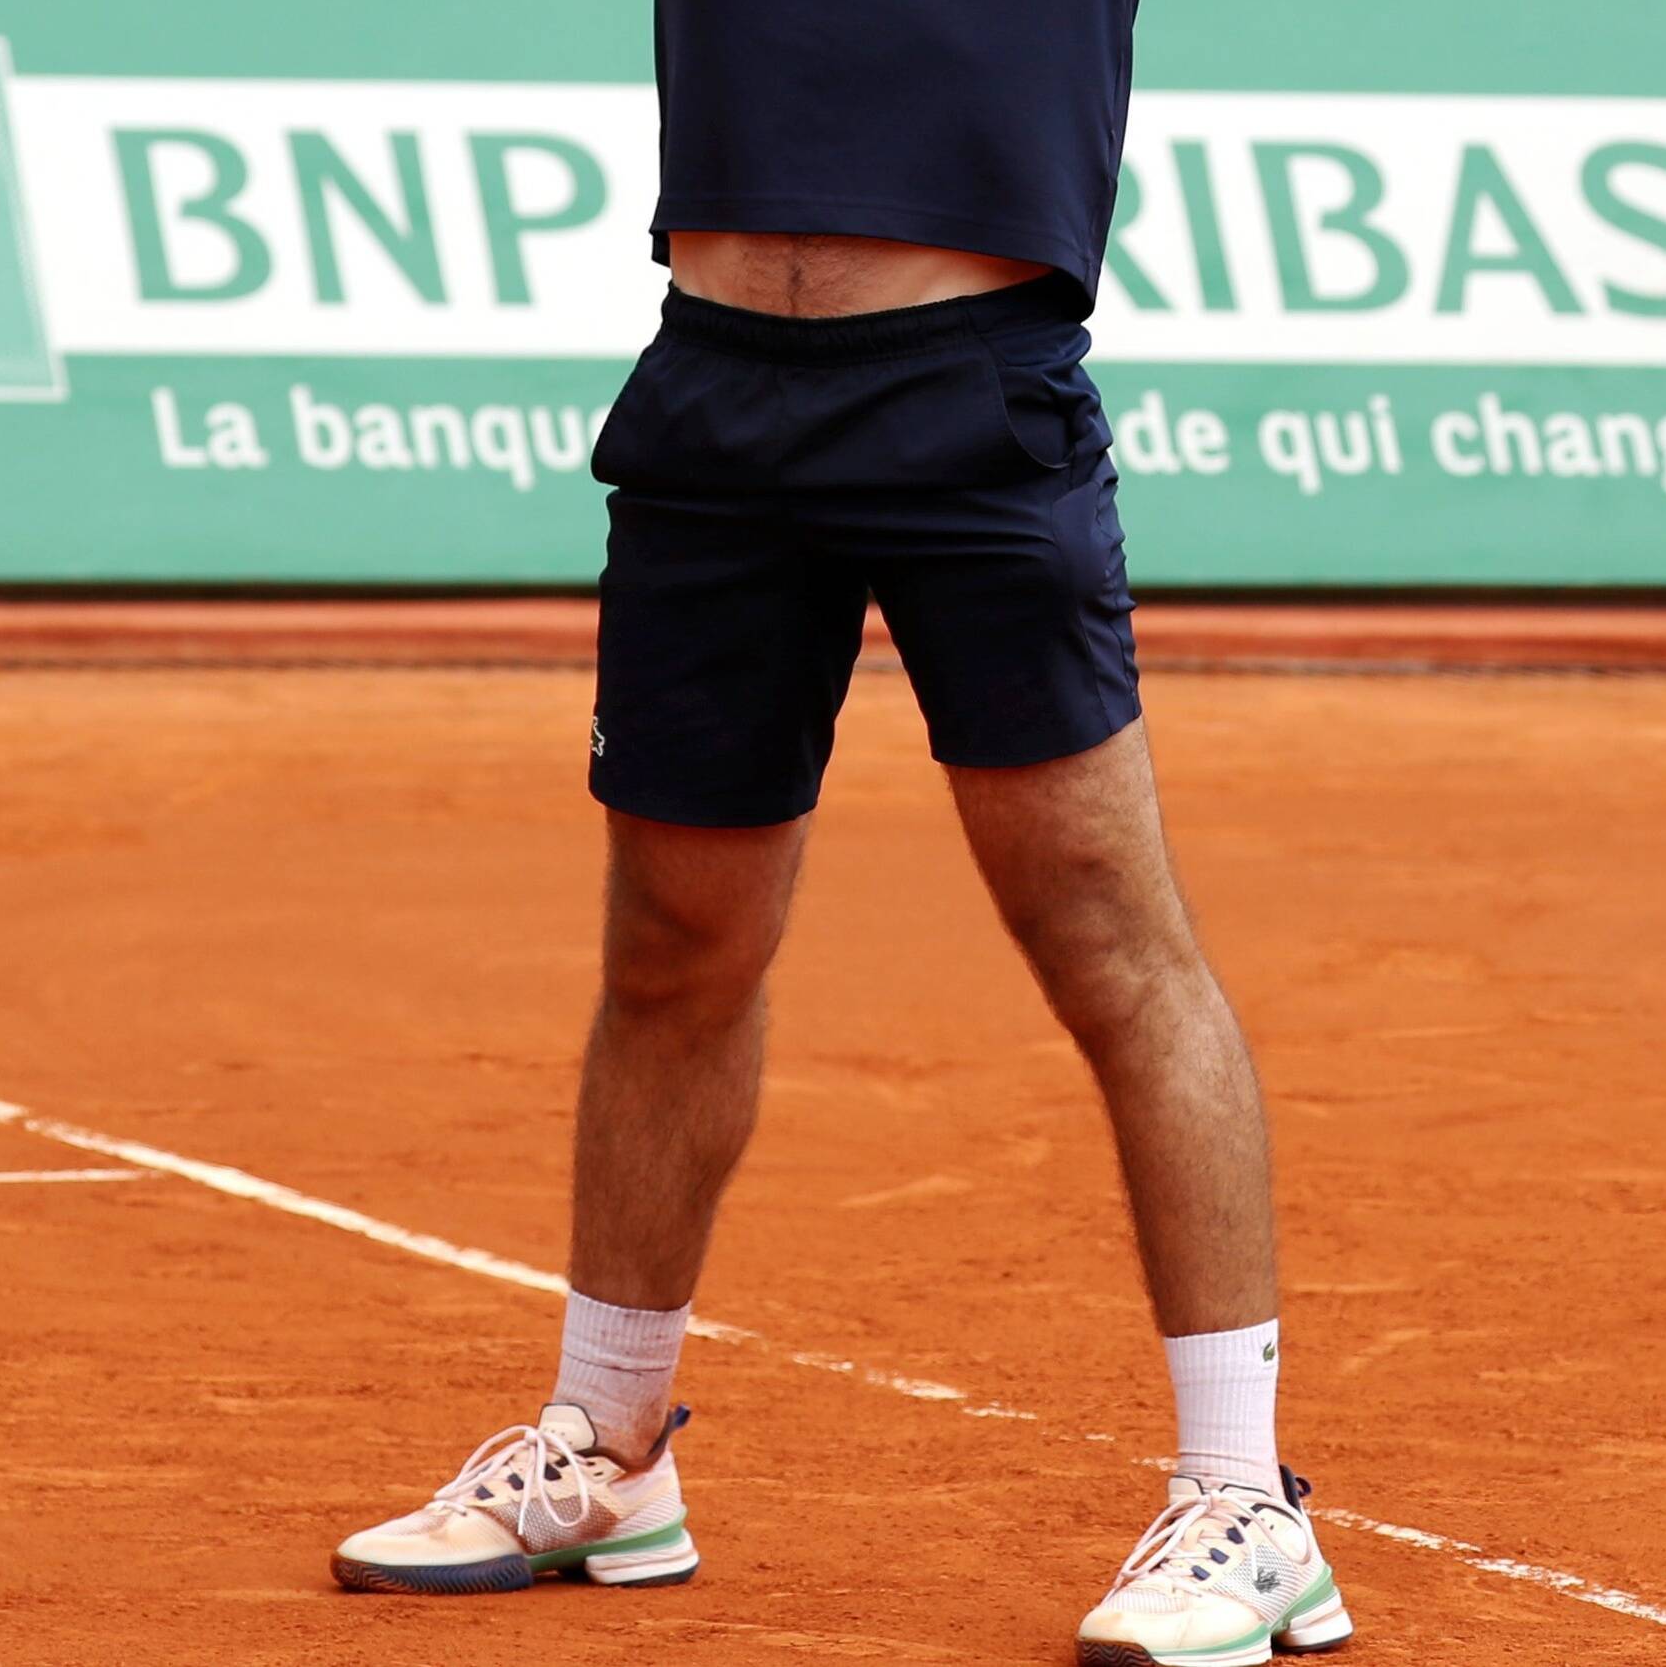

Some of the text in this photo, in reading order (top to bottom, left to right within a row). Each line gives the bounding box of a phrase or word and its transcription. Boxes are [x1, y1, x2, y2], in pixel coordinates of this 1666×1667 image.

[110, 126, 611, 307] BNP
[152, 387, 269, 469] La
[1108, 390, 1231, 475] de
[1259, 394, 1402, 494] qui
